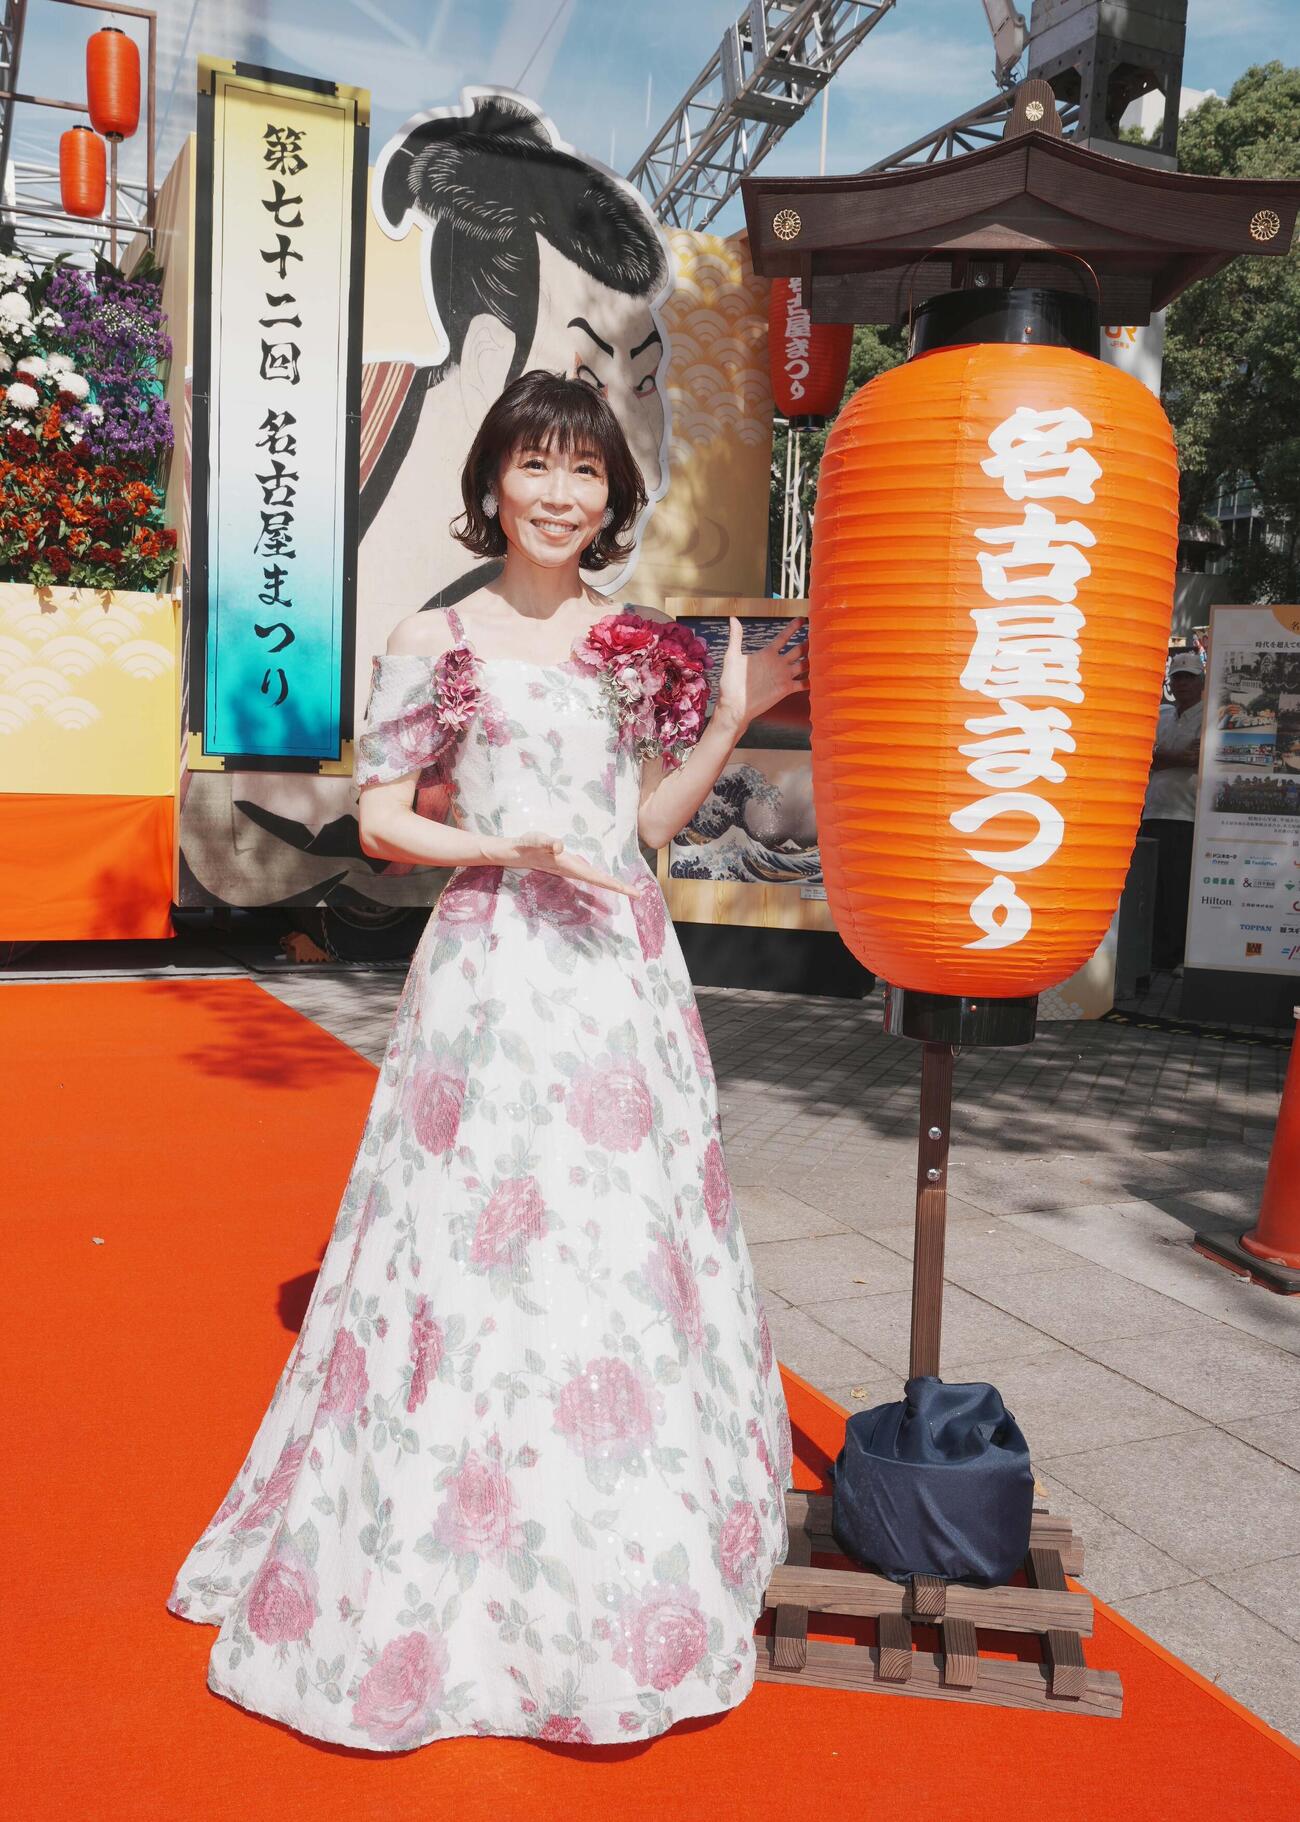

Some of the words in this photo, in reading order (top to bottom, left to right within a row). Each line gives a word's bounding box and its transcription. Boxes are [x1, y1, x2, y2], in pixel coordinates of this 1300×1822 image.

[259, 123, 308, 386] 第七十二回
[254, 409, 300, 708] 名古屋まつり
[948, 406, 1103, 950] 名古屋まつり
[1201, 896, 1232, 906] Hilton
[1239, 924, 1272, 932] TOPPAN
